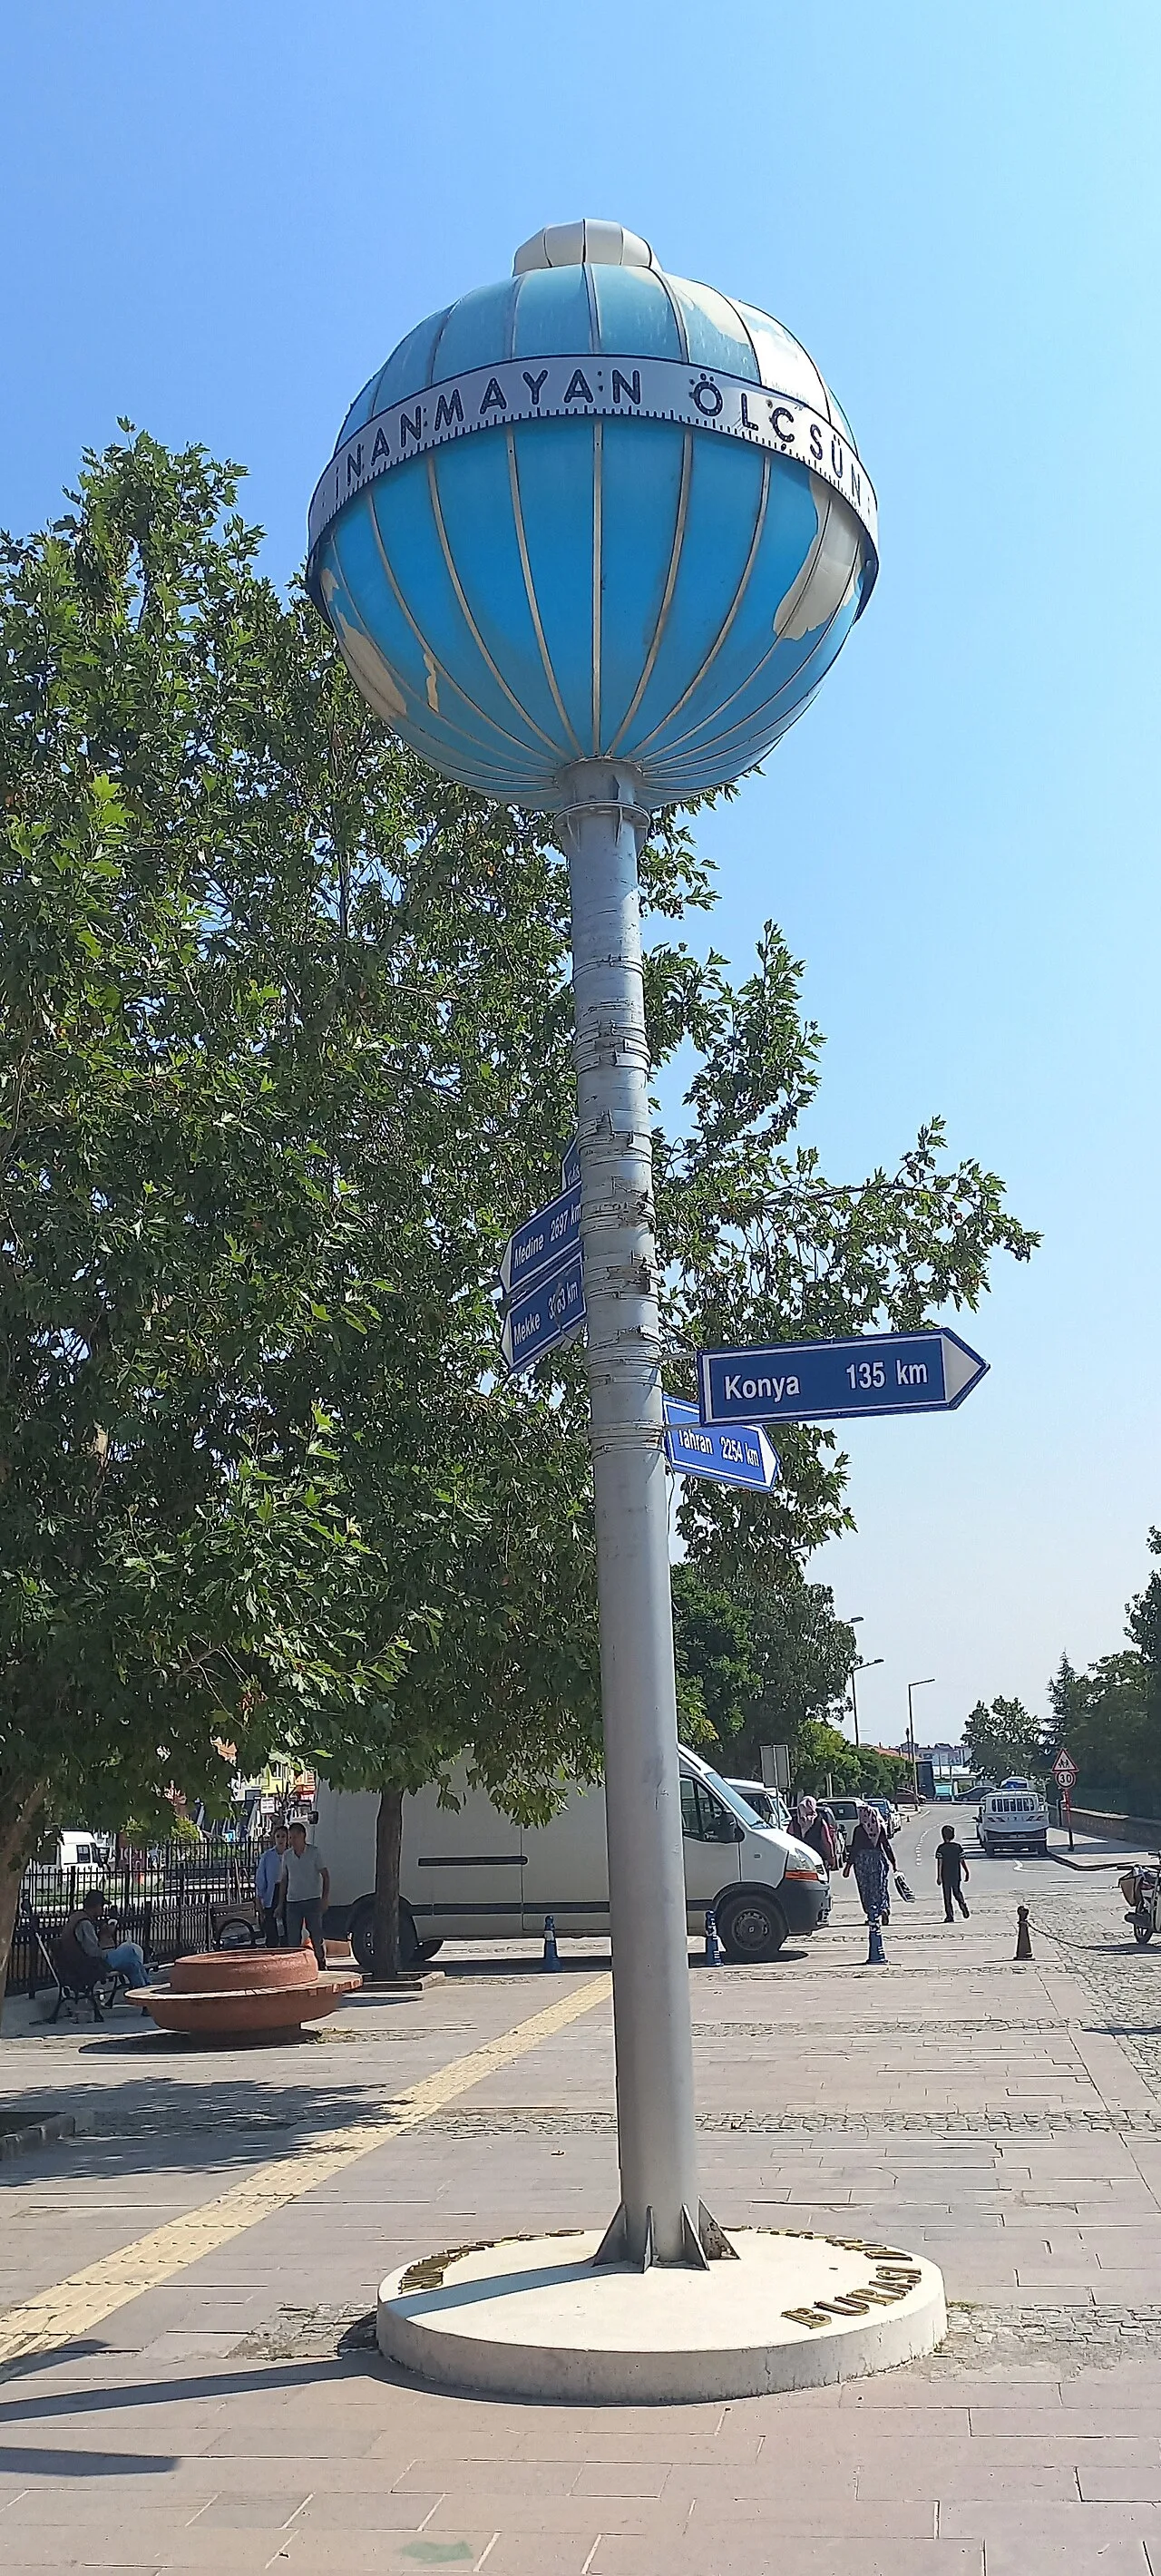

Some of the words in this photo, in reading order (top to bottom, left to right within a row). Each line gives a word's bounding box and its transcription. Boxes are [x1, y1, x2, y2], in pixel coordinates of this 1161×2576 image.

[691, 373, 862, 507] ÖLÇSÜN
[513, 1234, 544, 1269] Medine
[550, 1209, 569, 1243] 2697
[571, 1203, 581, 1225] km
[513, 1313, 541, 1346] Mekke
[548, 1288, 566, 1320] 363
[566, 1282, 579, 1305] km
[724, 1373, 801, 1403] Konya
[845, 1361, 885, 1390] 135
[896, 1360, 928, 1386] km
[720, 1436, 744, 1463] 2254
[745, 1442, 760, 1468] km
[1059, 1773, 1071, 1784] 30
[781, 2265, 922, 2329] BURASI
